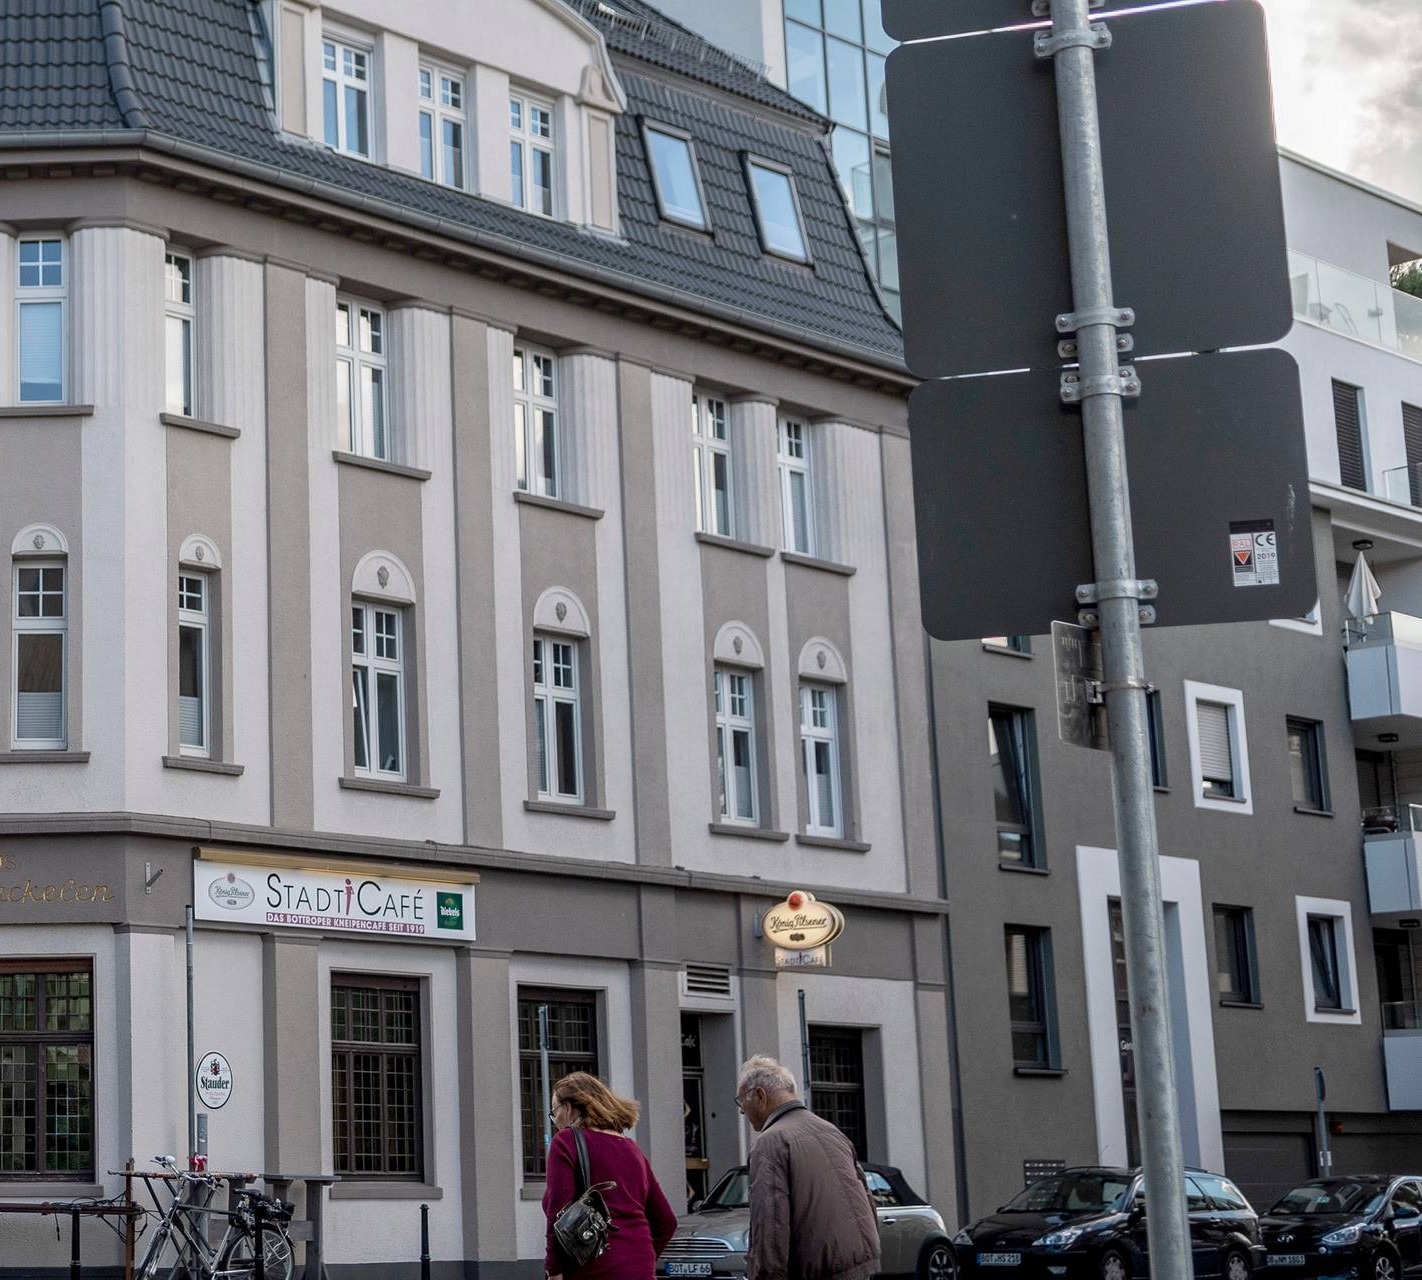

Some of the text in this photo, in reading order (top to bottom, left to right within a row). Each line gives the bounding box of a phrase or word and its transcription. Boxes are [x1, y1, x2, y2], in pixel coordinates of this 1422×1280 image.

[1257, 552, 1276, 560] 2019
[267, 912, 284, 922] DAS
[286, 914, 332, 926] BOTTROPER
[388, 922, 404, 932] SEIT
[406, 924, 424, 934] 1919
[769, 916, 794, 930] König
[200, 1075, 230, 1091] Stauder
